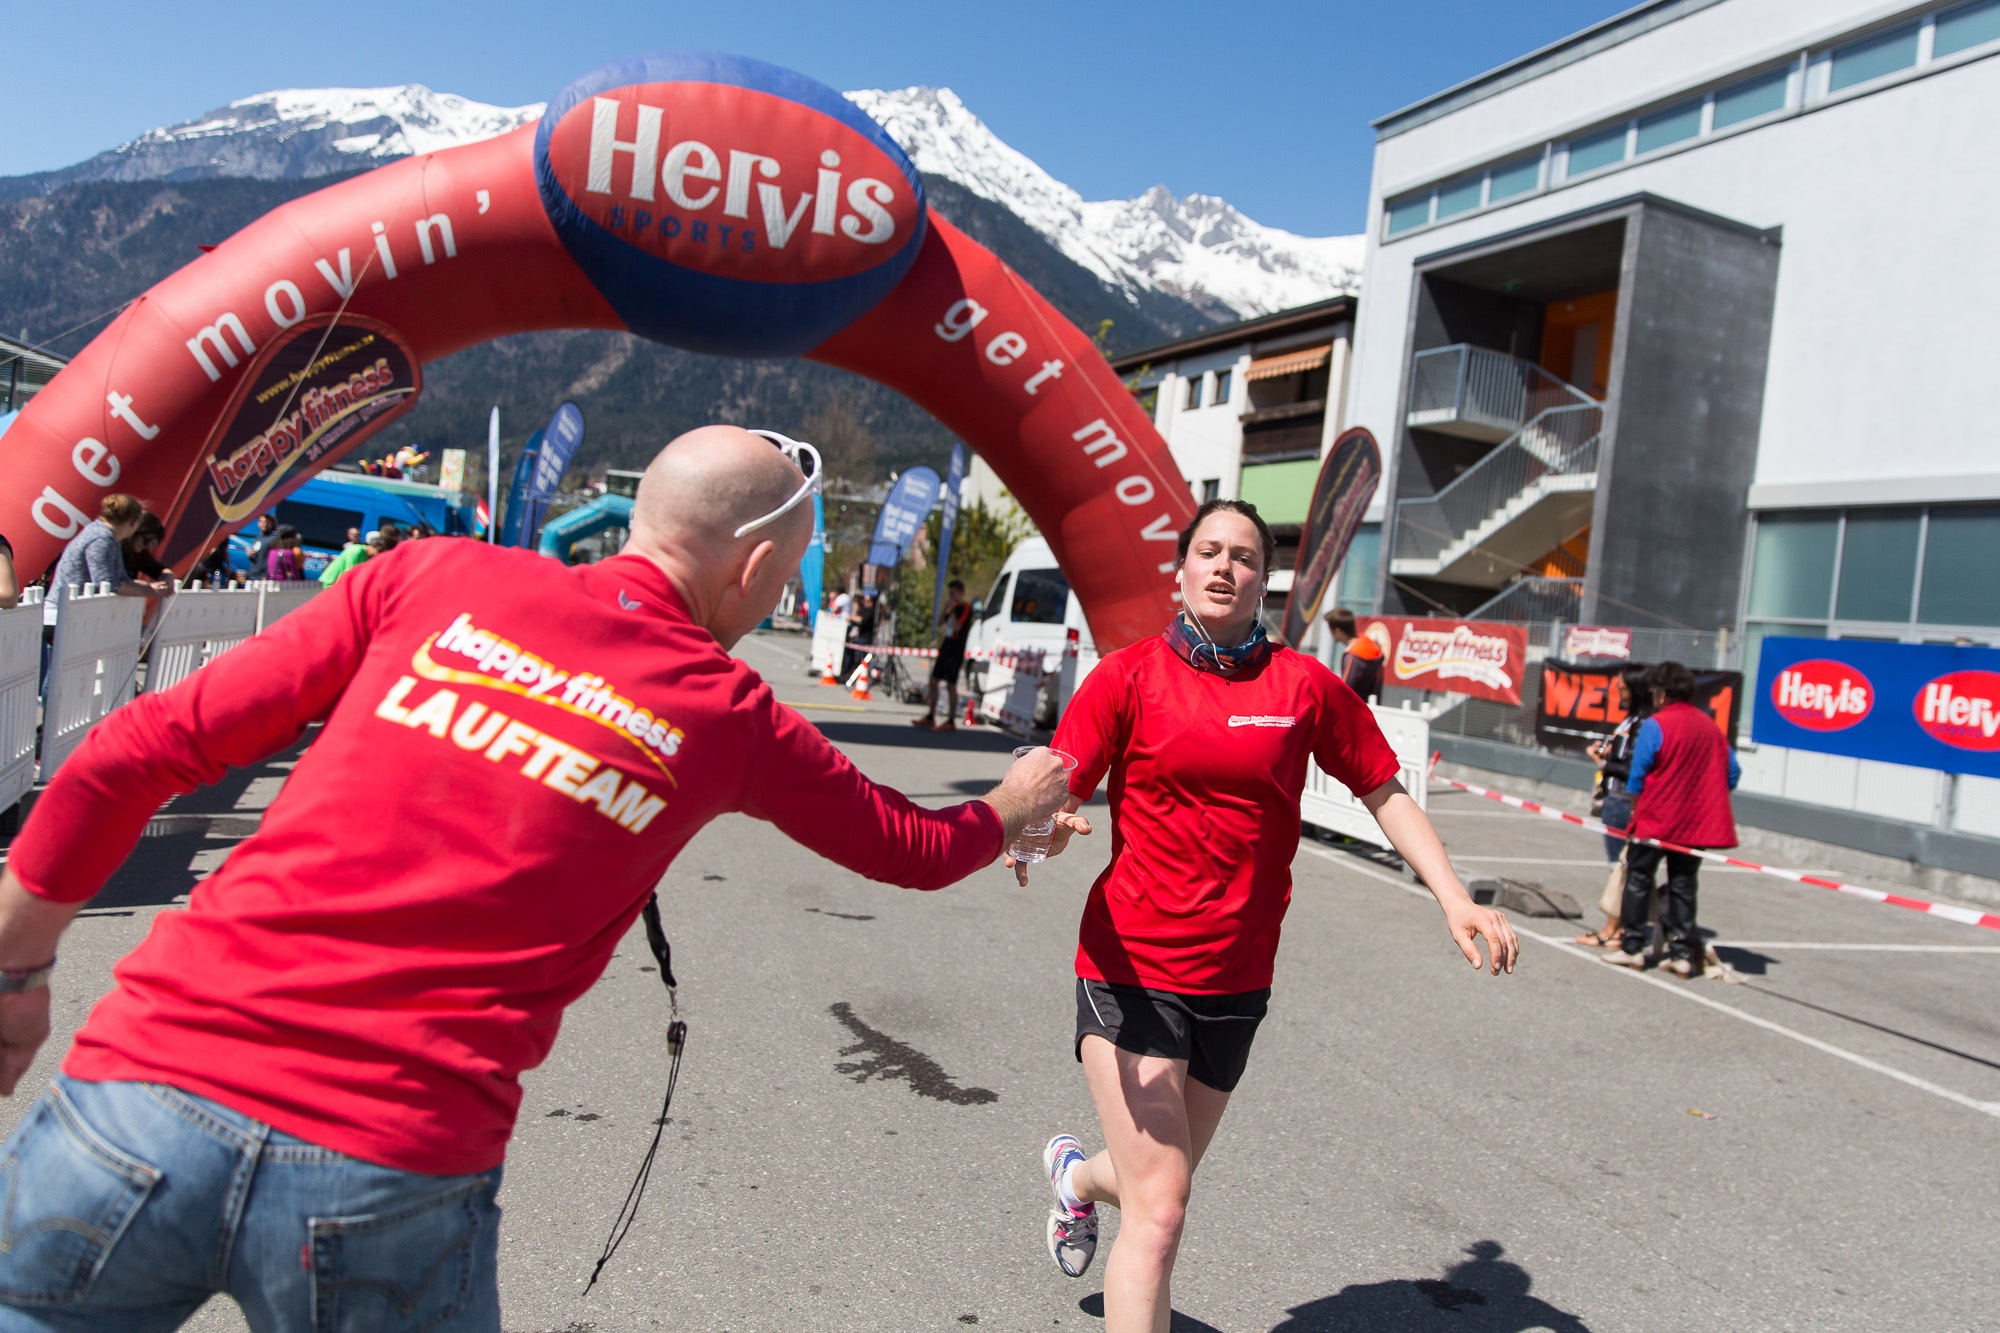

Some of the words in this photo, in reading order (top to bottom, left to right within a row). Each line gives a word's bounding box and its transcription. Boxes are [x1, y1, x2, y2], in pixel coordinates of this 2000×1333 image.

[586, 96, 896, 249] Hervis
[610, 205, 757, 252] SPORTS
[31, 389, 161, 540] get
[205, 411, 304, 496] happy
[301, 357, 395, 432] fitness
[935, 298, 1066, 396] get
[1072, 418, 1183, 602] mov
[435, 613, 570, 696] happy
[561, 672, 685, 757] fitness
[1403, 622, 1451, 669] happy
[1451, 626, 1508, 666] fitness
[1544, 669, 1629, 724] WEL
[1778, 670, 1868, 720] Hervis
[1923, 682, 2000, 738] Herv
[375, 675, 668, 835] LAUFTEAM
